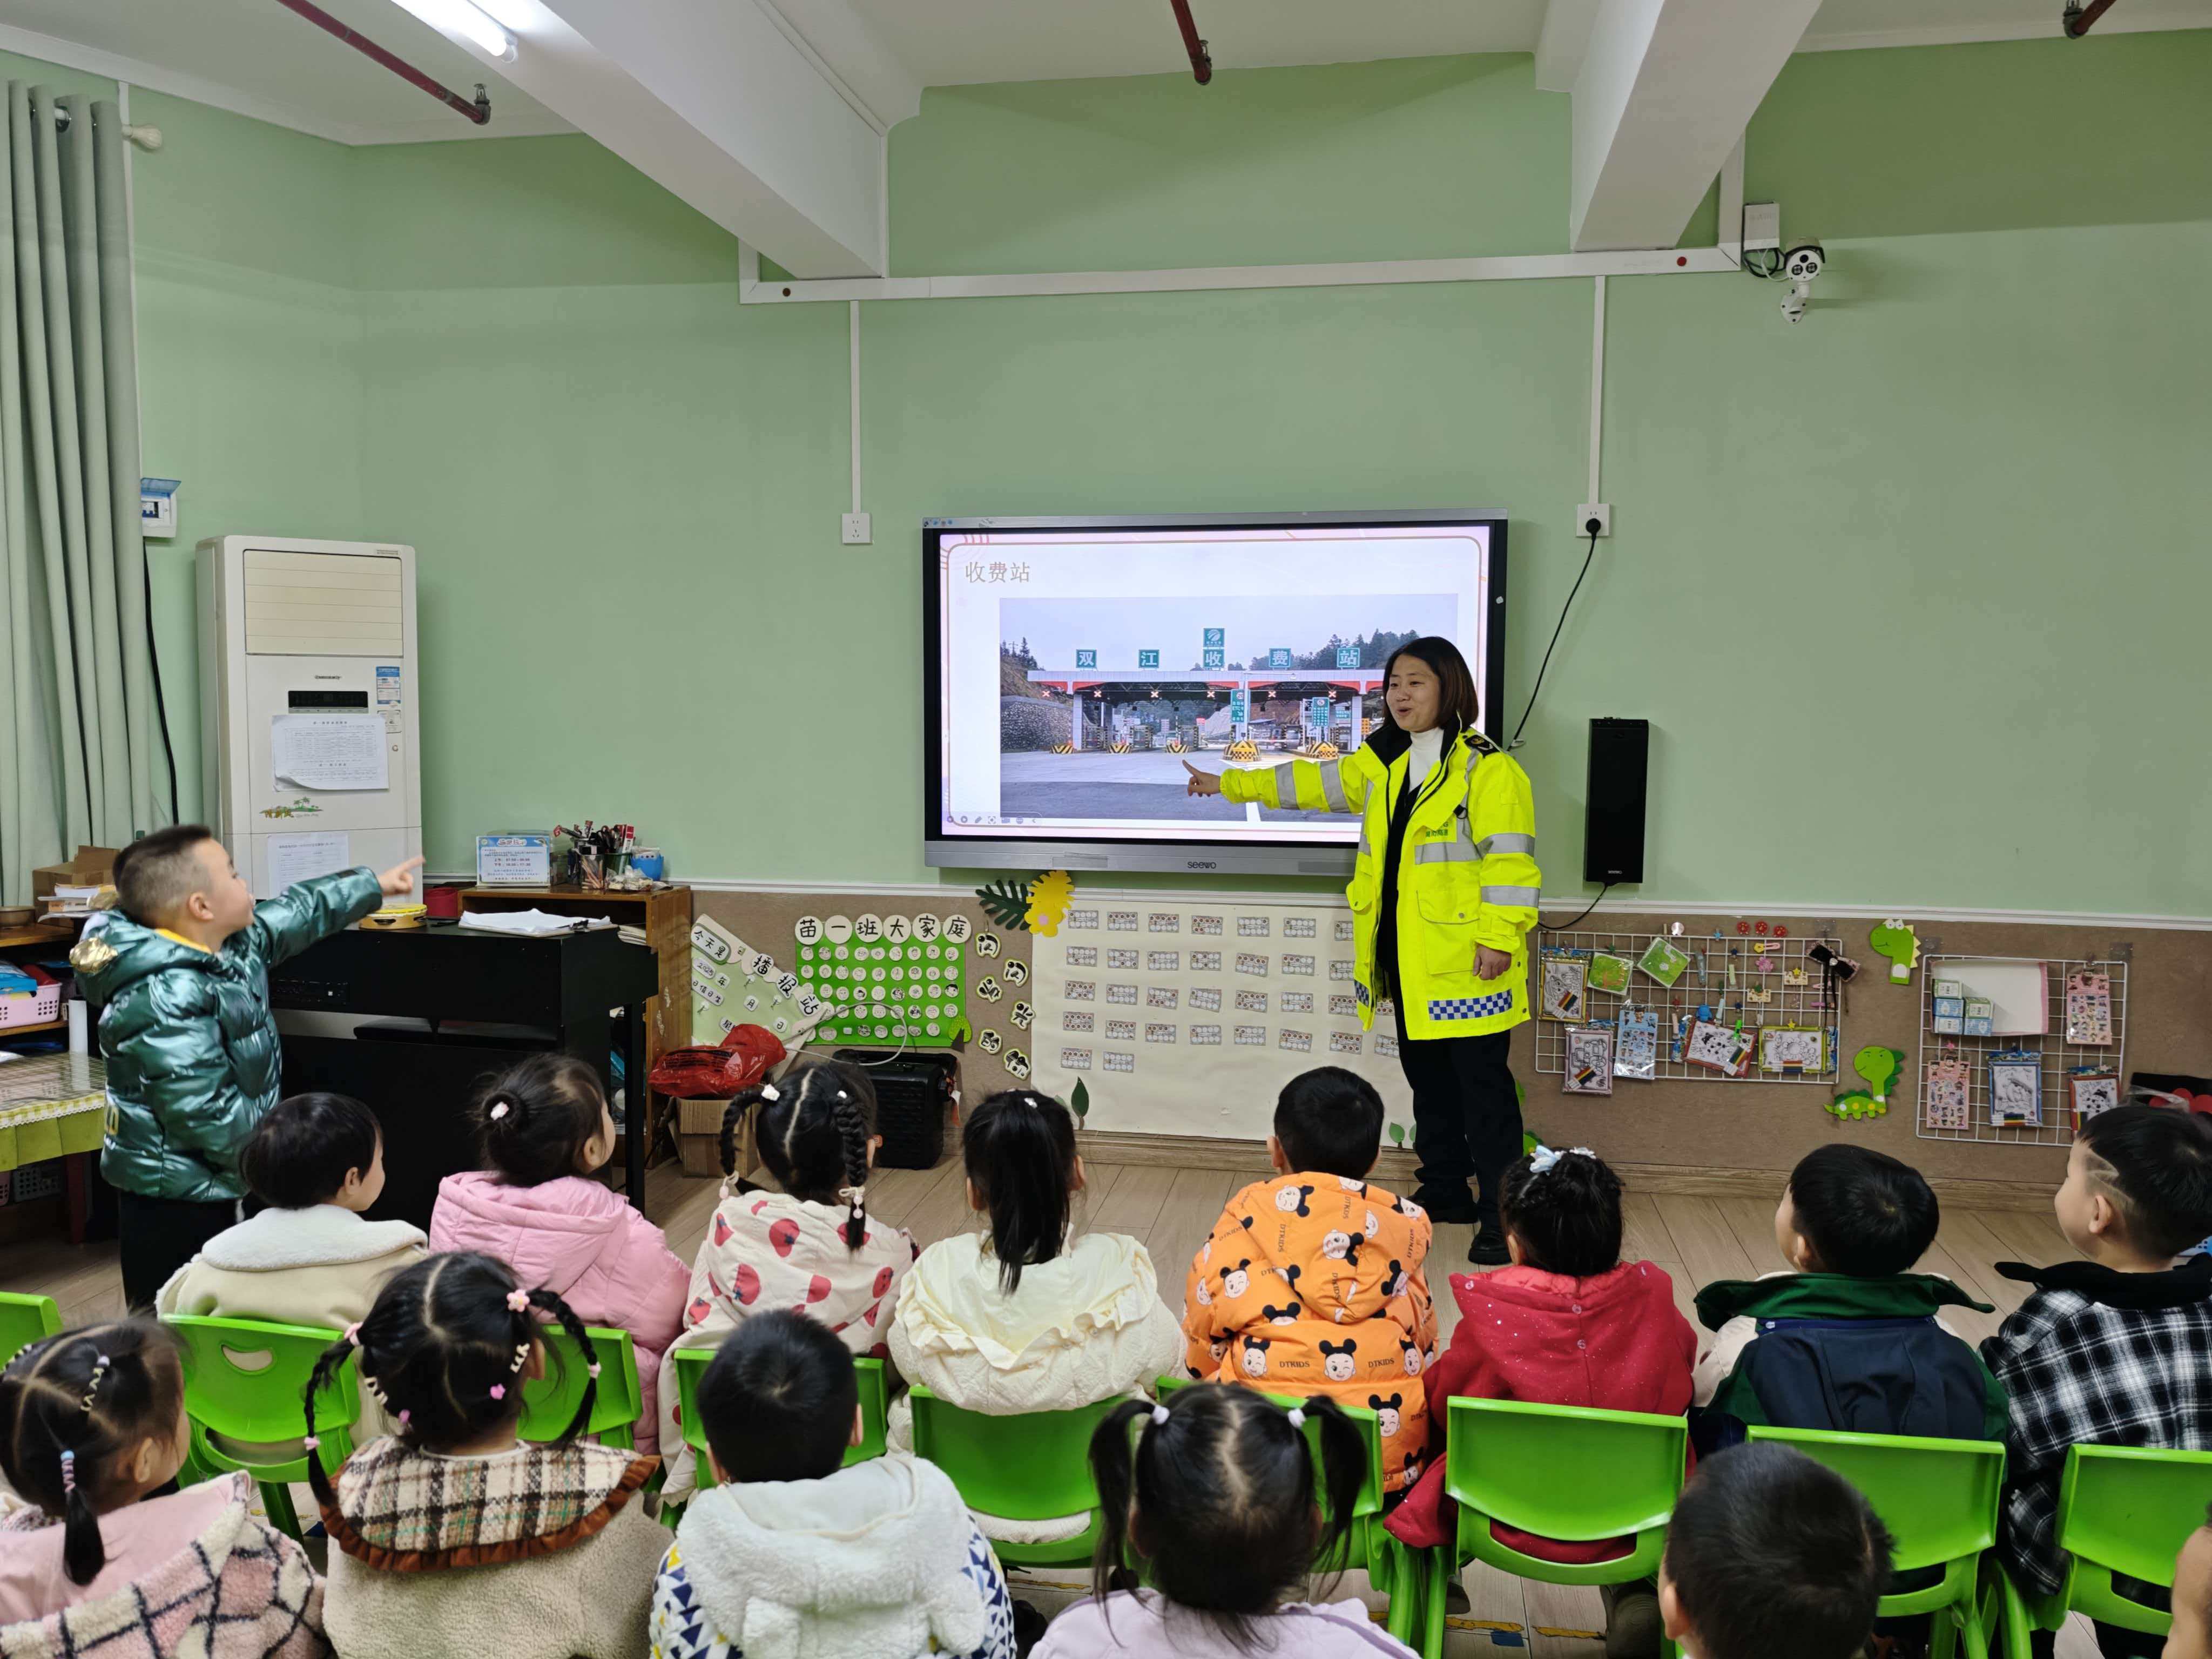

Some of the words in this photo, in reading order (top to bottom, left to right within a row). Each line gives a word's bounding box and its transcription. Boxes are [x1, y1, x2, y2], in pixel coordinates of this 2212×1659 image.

[965, 561, 1030, 583] 收费站
[799, 916, 968, 939] 苗一班大家庭
[694, 930, 726, 958] 今天是
[718, 976, 727, 986] 年
[753, 955, 820, 1015] 播报站
[748, 999, 755, 1008] 月
[1278, 1223, 1287, 1253] DTKIDS
[1368, 1358, 1395, 1368] DTKIDS
